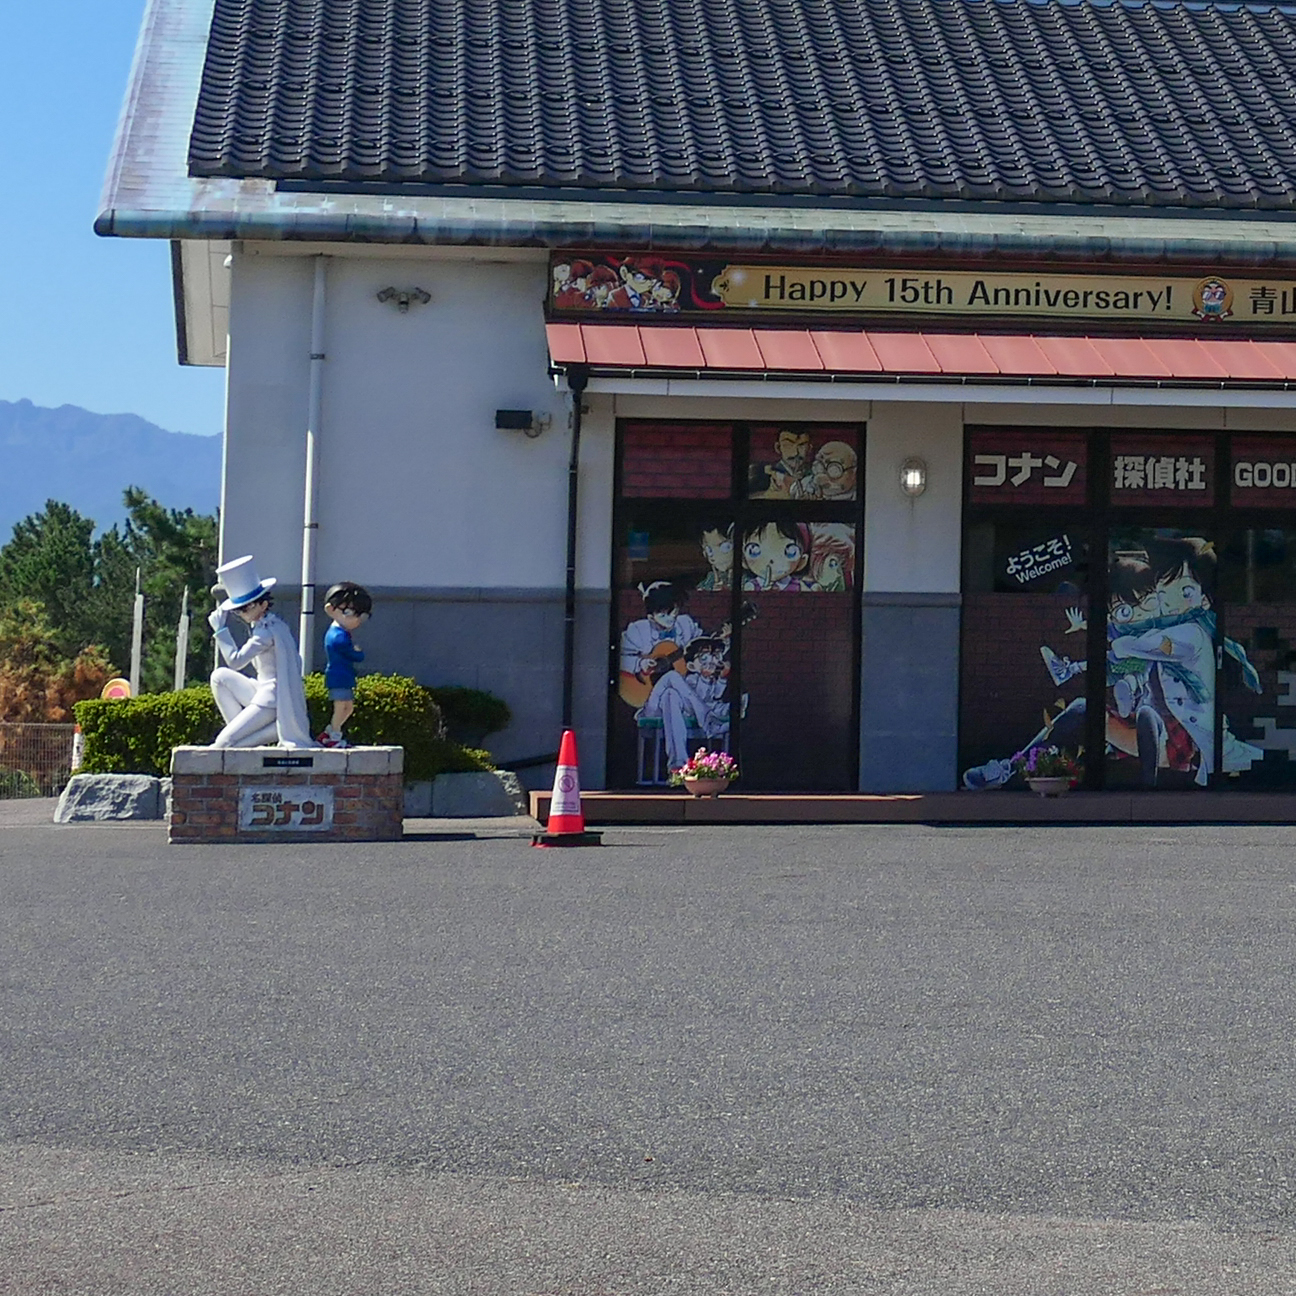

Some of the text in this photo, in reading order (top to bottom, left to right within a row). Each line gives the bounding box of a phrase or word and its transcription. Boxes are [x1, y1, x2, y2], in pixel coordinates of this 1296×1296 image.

[764, 274, 1173, 312] Happy 15th Anniversary!
[974, 451, 1078, 489] コナン
[1114, 456, 1206, 490] 探偵社
[1015, 552, 1073, 584] Welcome!
[249, 800, 325, 826] コナン
